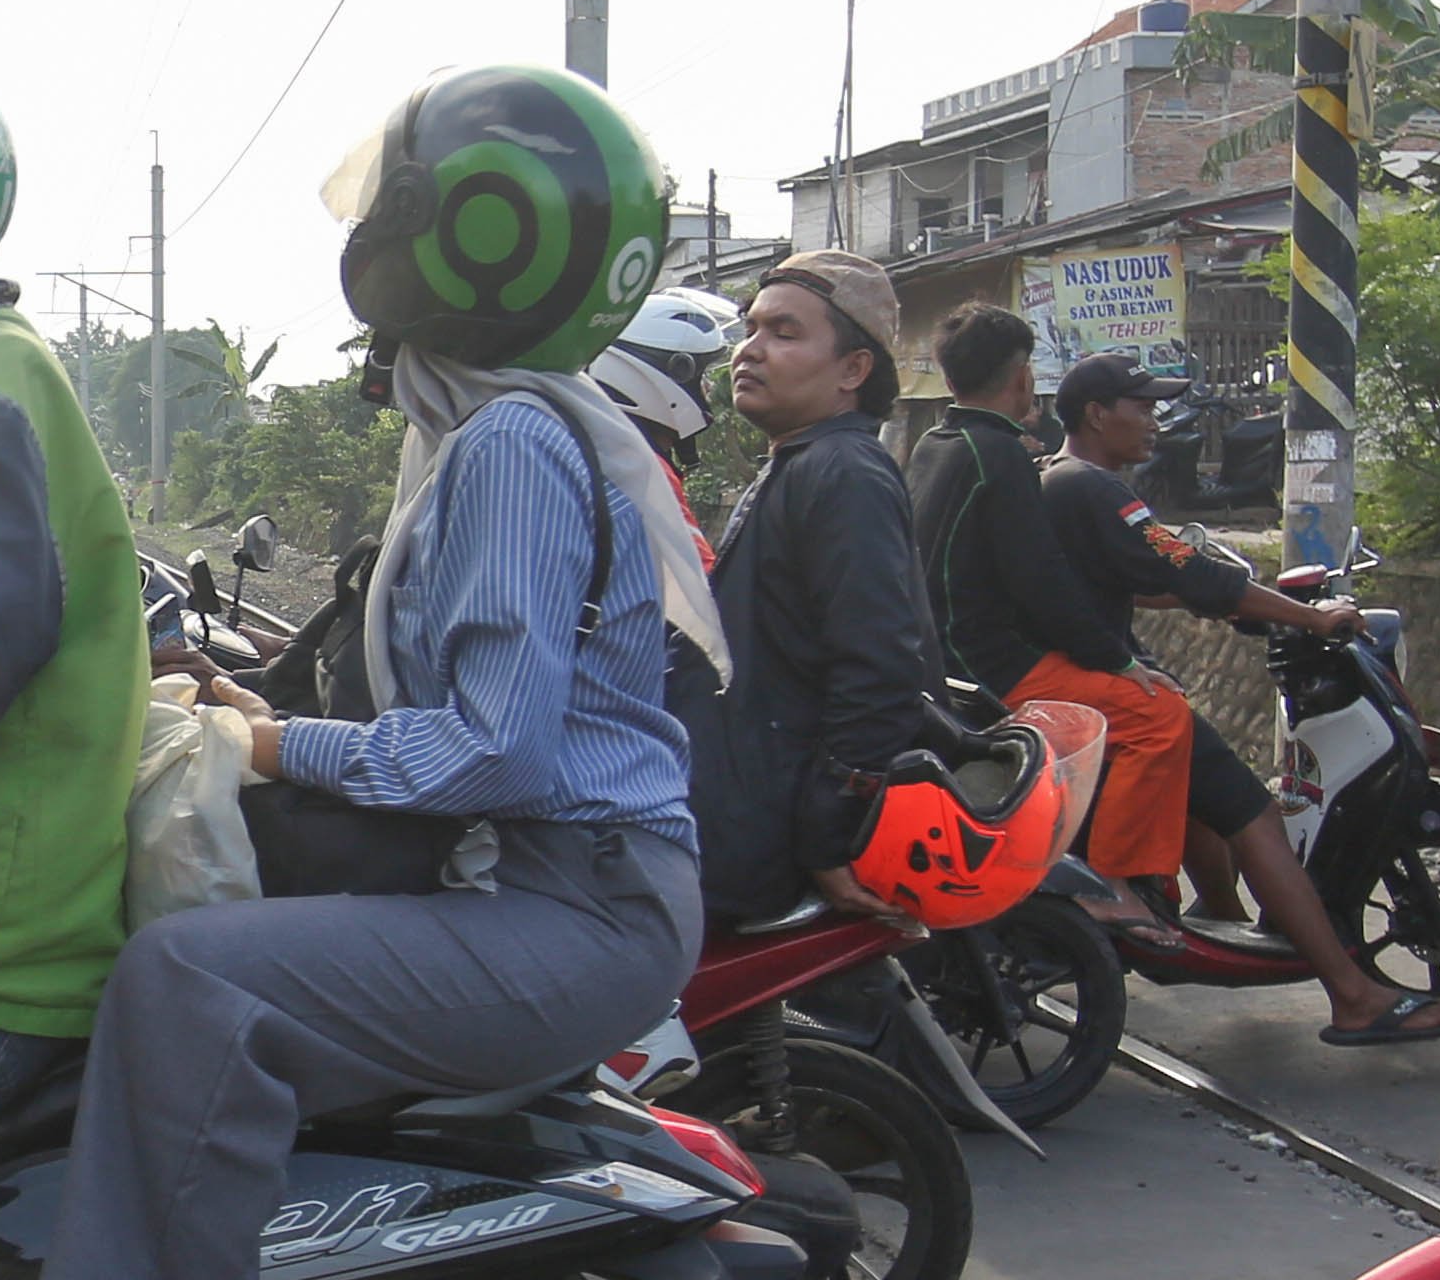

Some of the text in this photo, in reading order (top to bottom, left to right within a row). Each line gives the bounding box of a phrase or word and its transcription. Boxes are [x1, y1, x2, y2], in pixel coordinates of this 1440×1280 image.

[1063, 254, 1172, 287] NASI UDUK
[1099, 284, 1155, 302] ASINAN
[1069, 298, 1173, 321] SAYUR BETAWI
[380, 1201, 558, 1254] Genio
